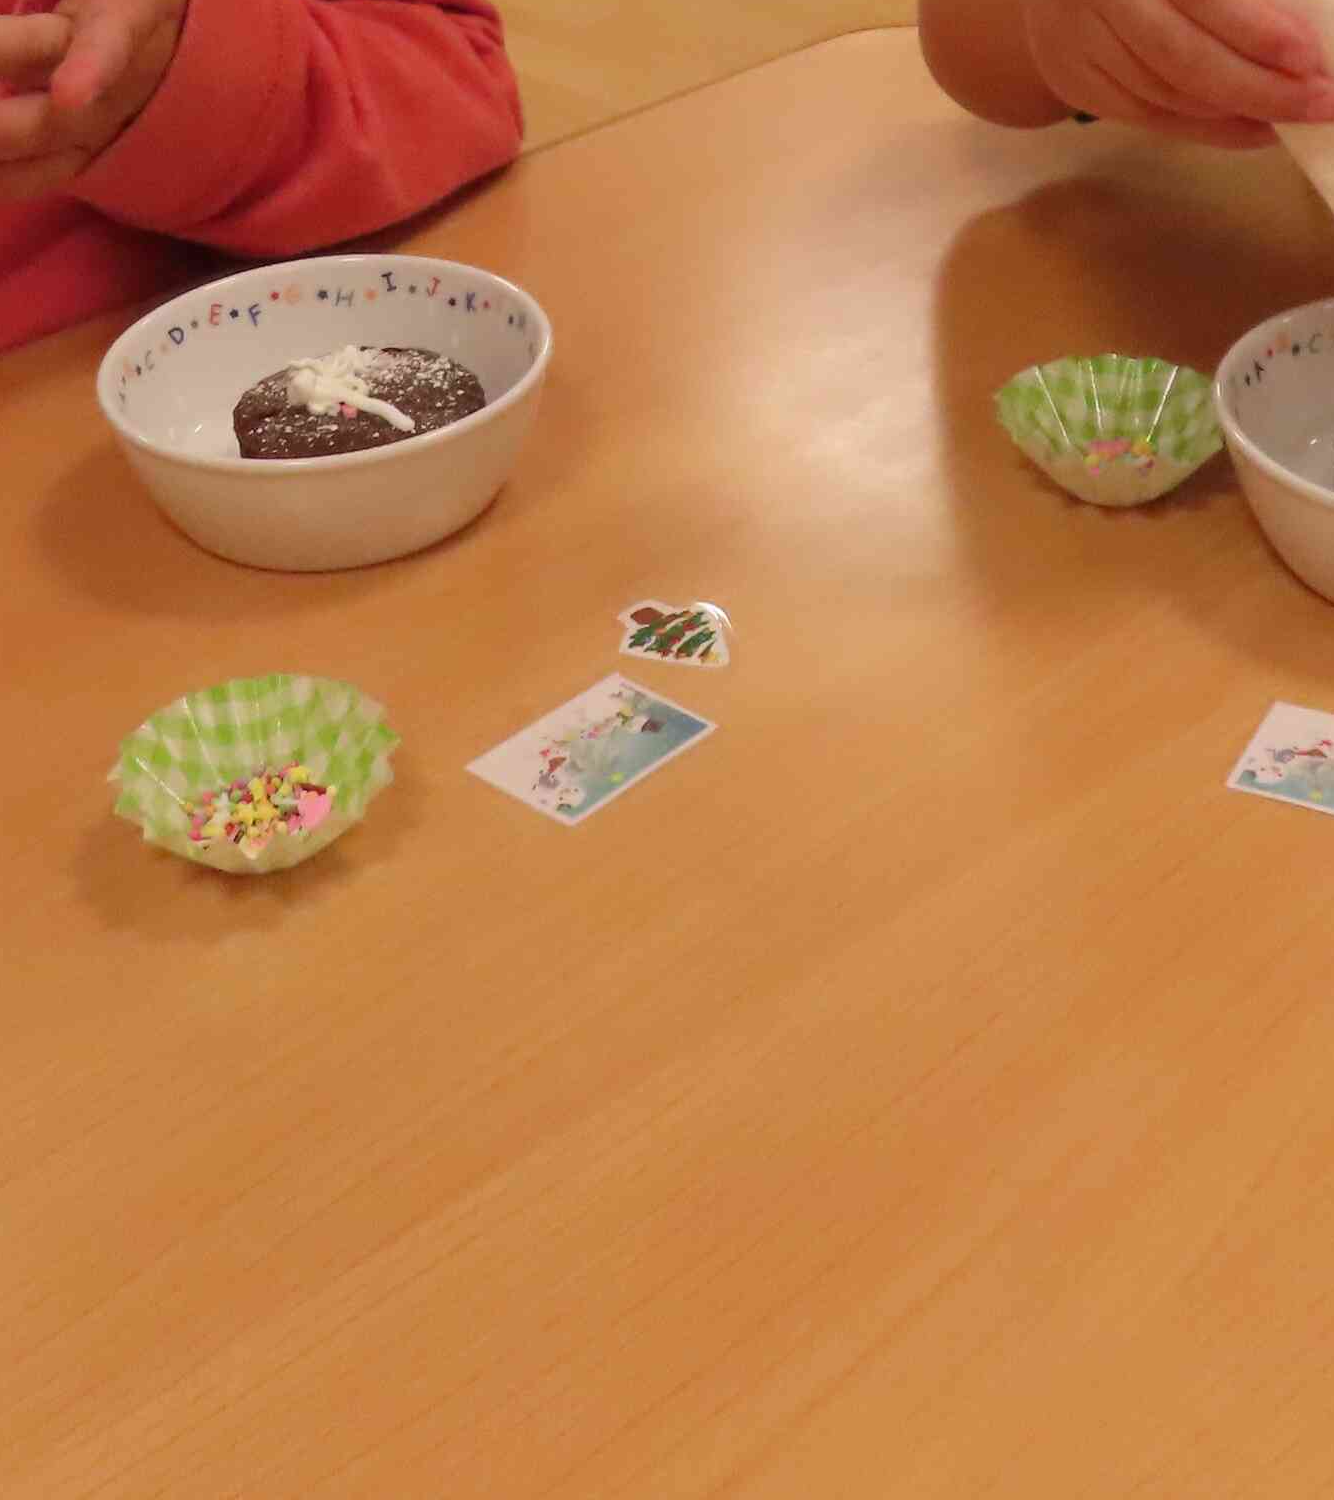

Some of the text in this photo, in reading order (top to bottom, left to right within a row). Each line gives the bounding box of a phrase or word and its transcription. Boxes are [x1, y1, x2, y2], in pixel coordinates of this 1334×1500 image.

[168, 327, 185, 346] D
[208, 303, 222, 326] E
[248, 303, 262, 326] F
[335, 286, 355, 308] H
[381, 271, 397, 292] I
[427, 277, 441, 297] J
